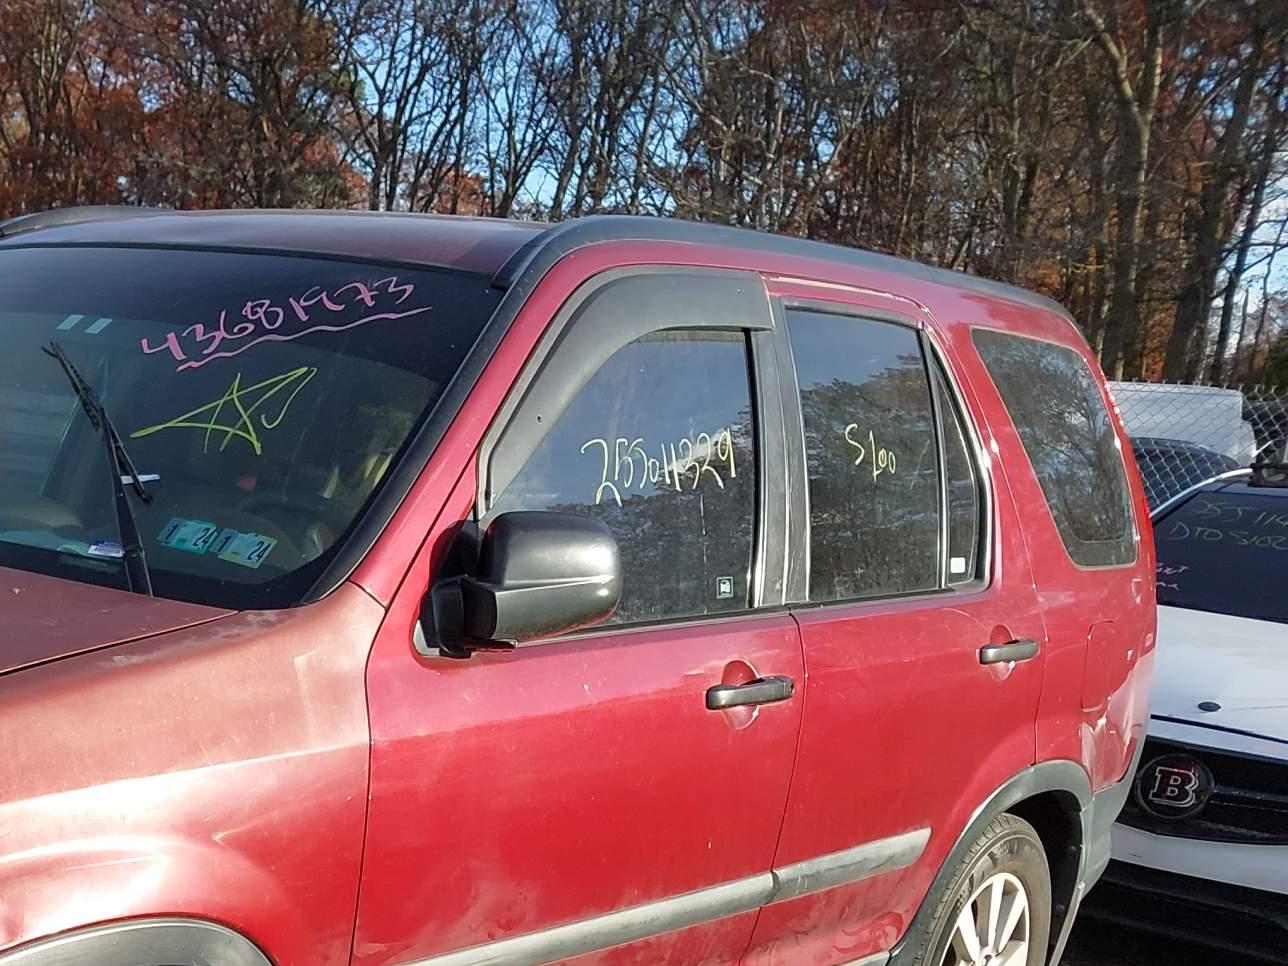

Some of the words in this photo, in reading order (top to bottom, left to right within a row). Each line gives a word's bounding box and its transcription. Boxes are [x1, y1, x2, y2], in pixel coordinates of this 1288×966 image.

[141, 276, 414, 361] 43681973
[191, 526, 216, 549] 24
[247, 540, 273, 563] 24
[1149, 766, 1199, 808] B
